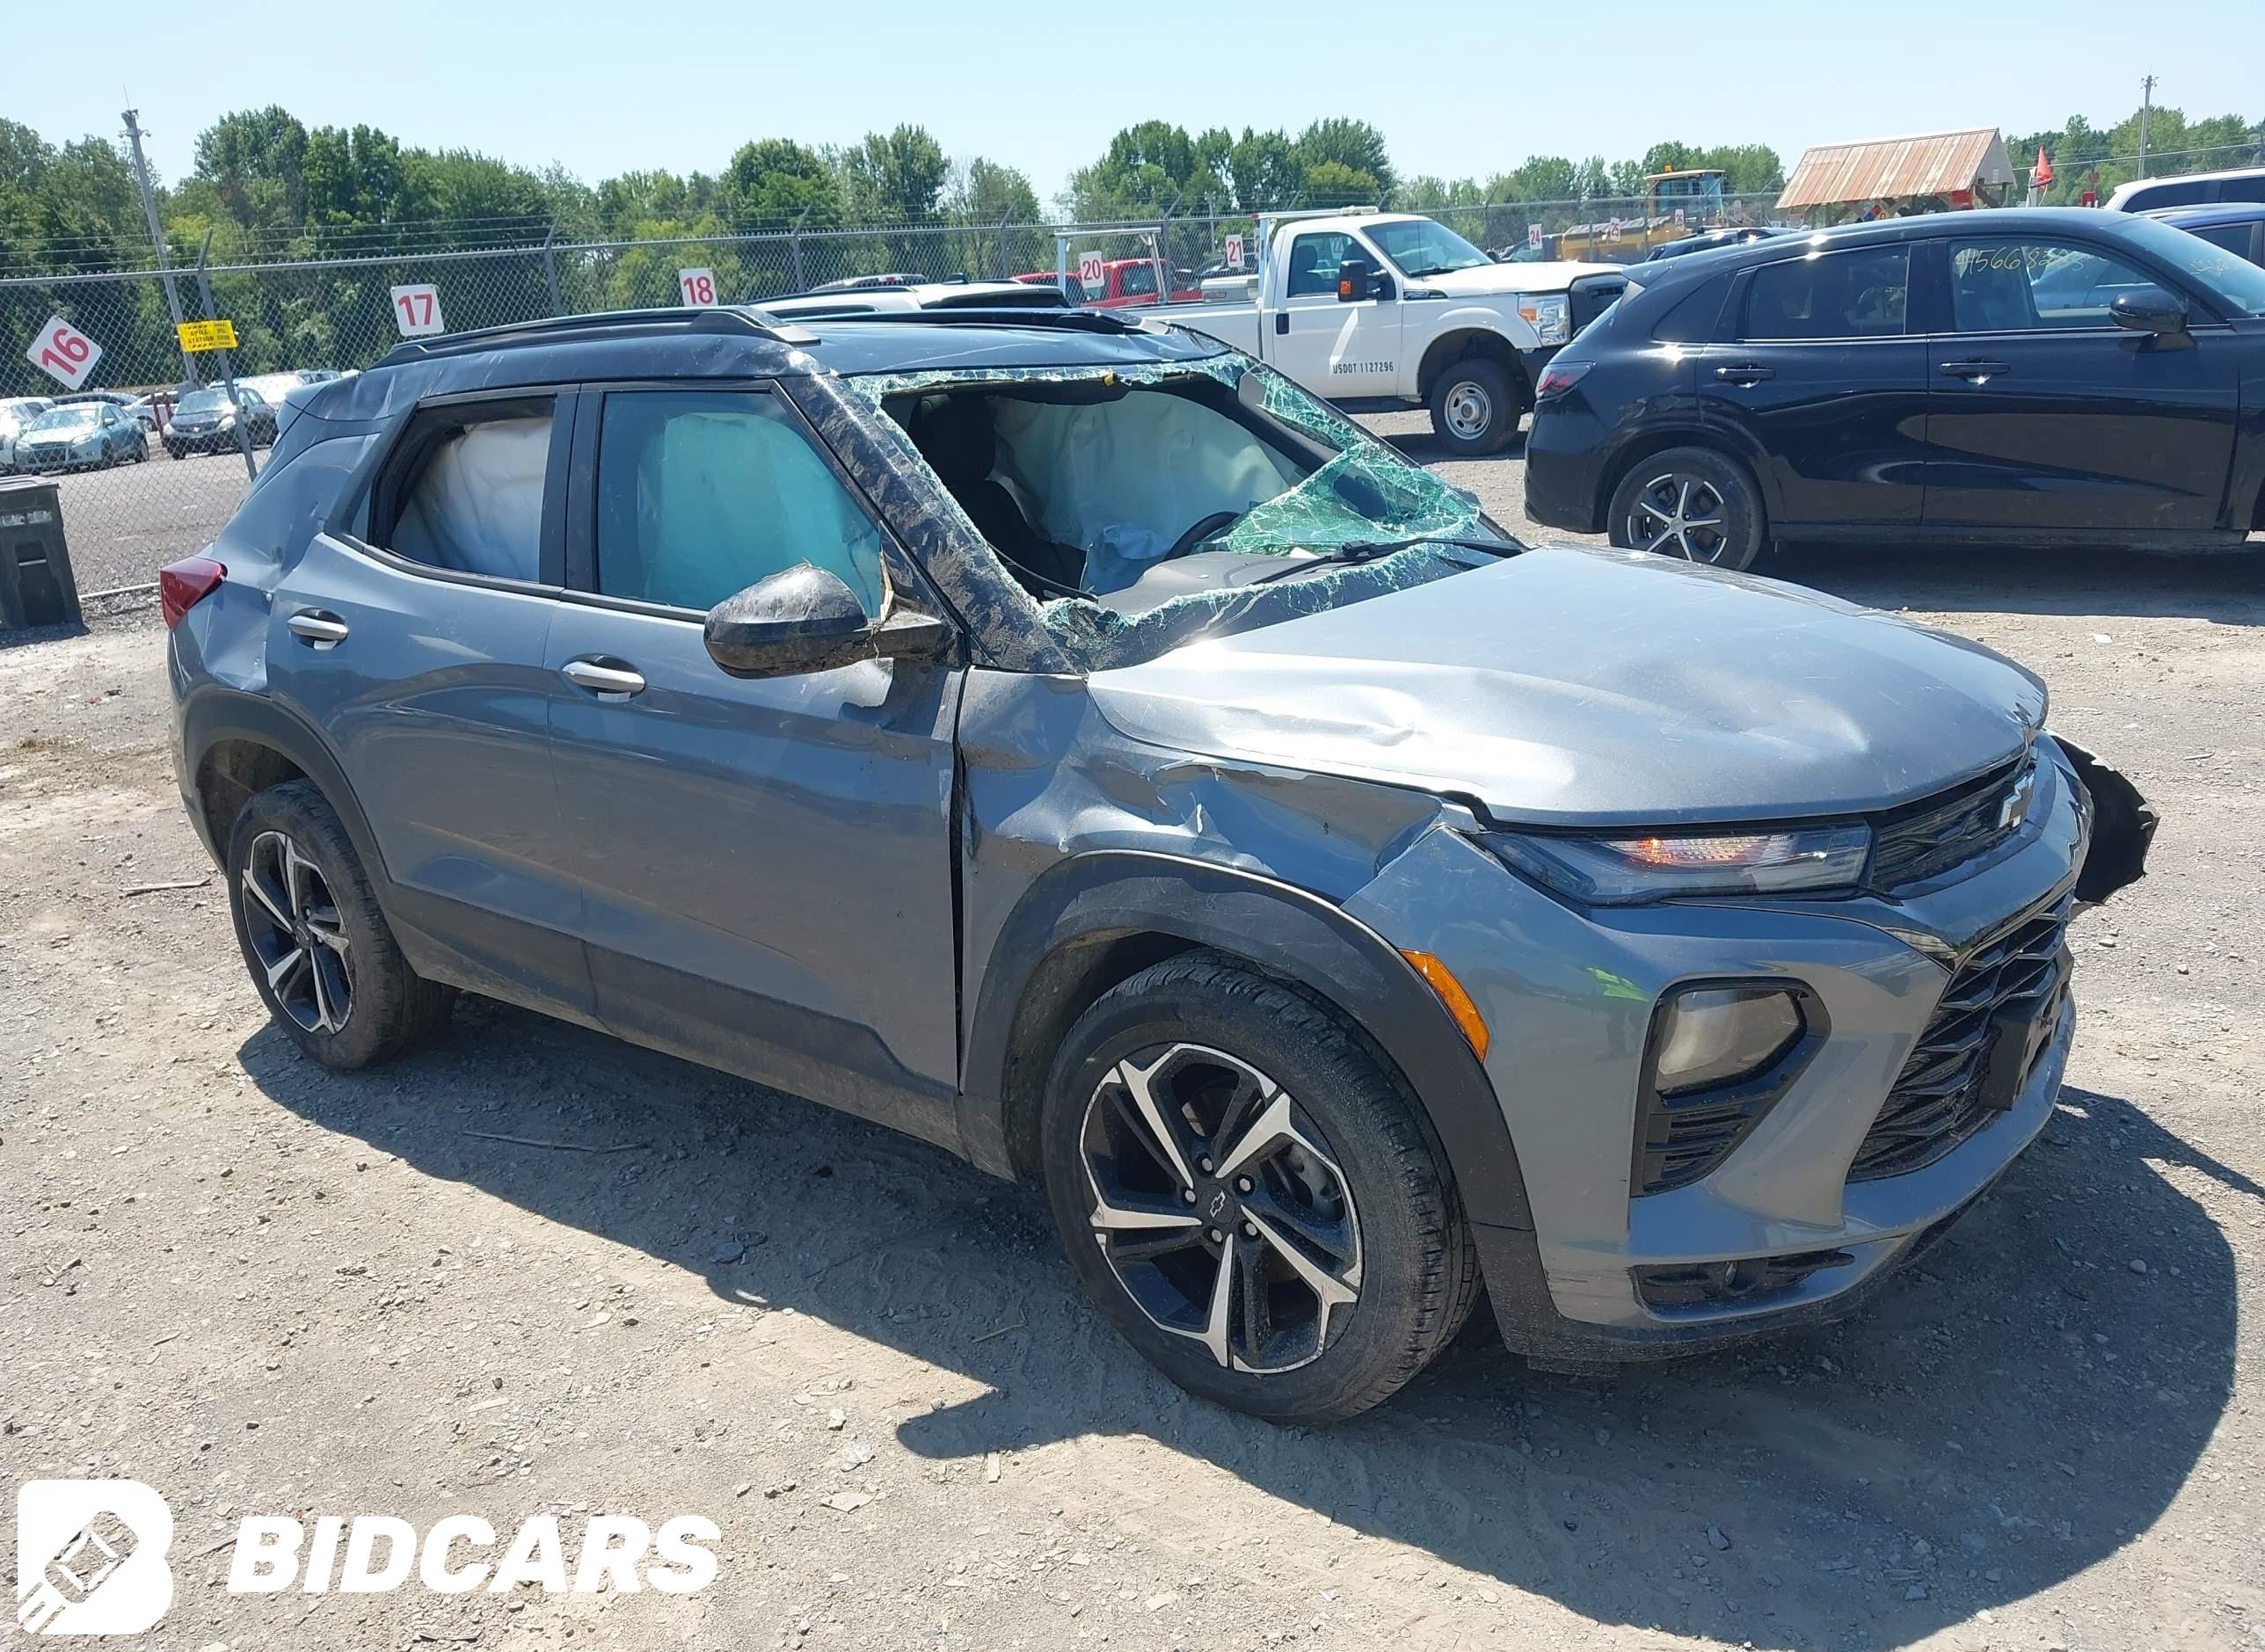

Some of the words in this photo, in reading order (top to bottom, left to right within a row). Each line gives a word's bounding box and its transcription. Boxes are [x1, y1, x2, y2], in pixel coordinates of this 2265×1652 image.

[1530, 230, 1540, 244] 24
[1227, 240, 1242, 262] 21
[1082, 258, 1101, 280] 20
[683, 276, 713, 304] 18
[397, 294, 433, 326] 17
[41, 328, 89, 375] 16
[1333, 362, 1357, 374] USDOT
[1359, 361, 1394, 373] 1127296
